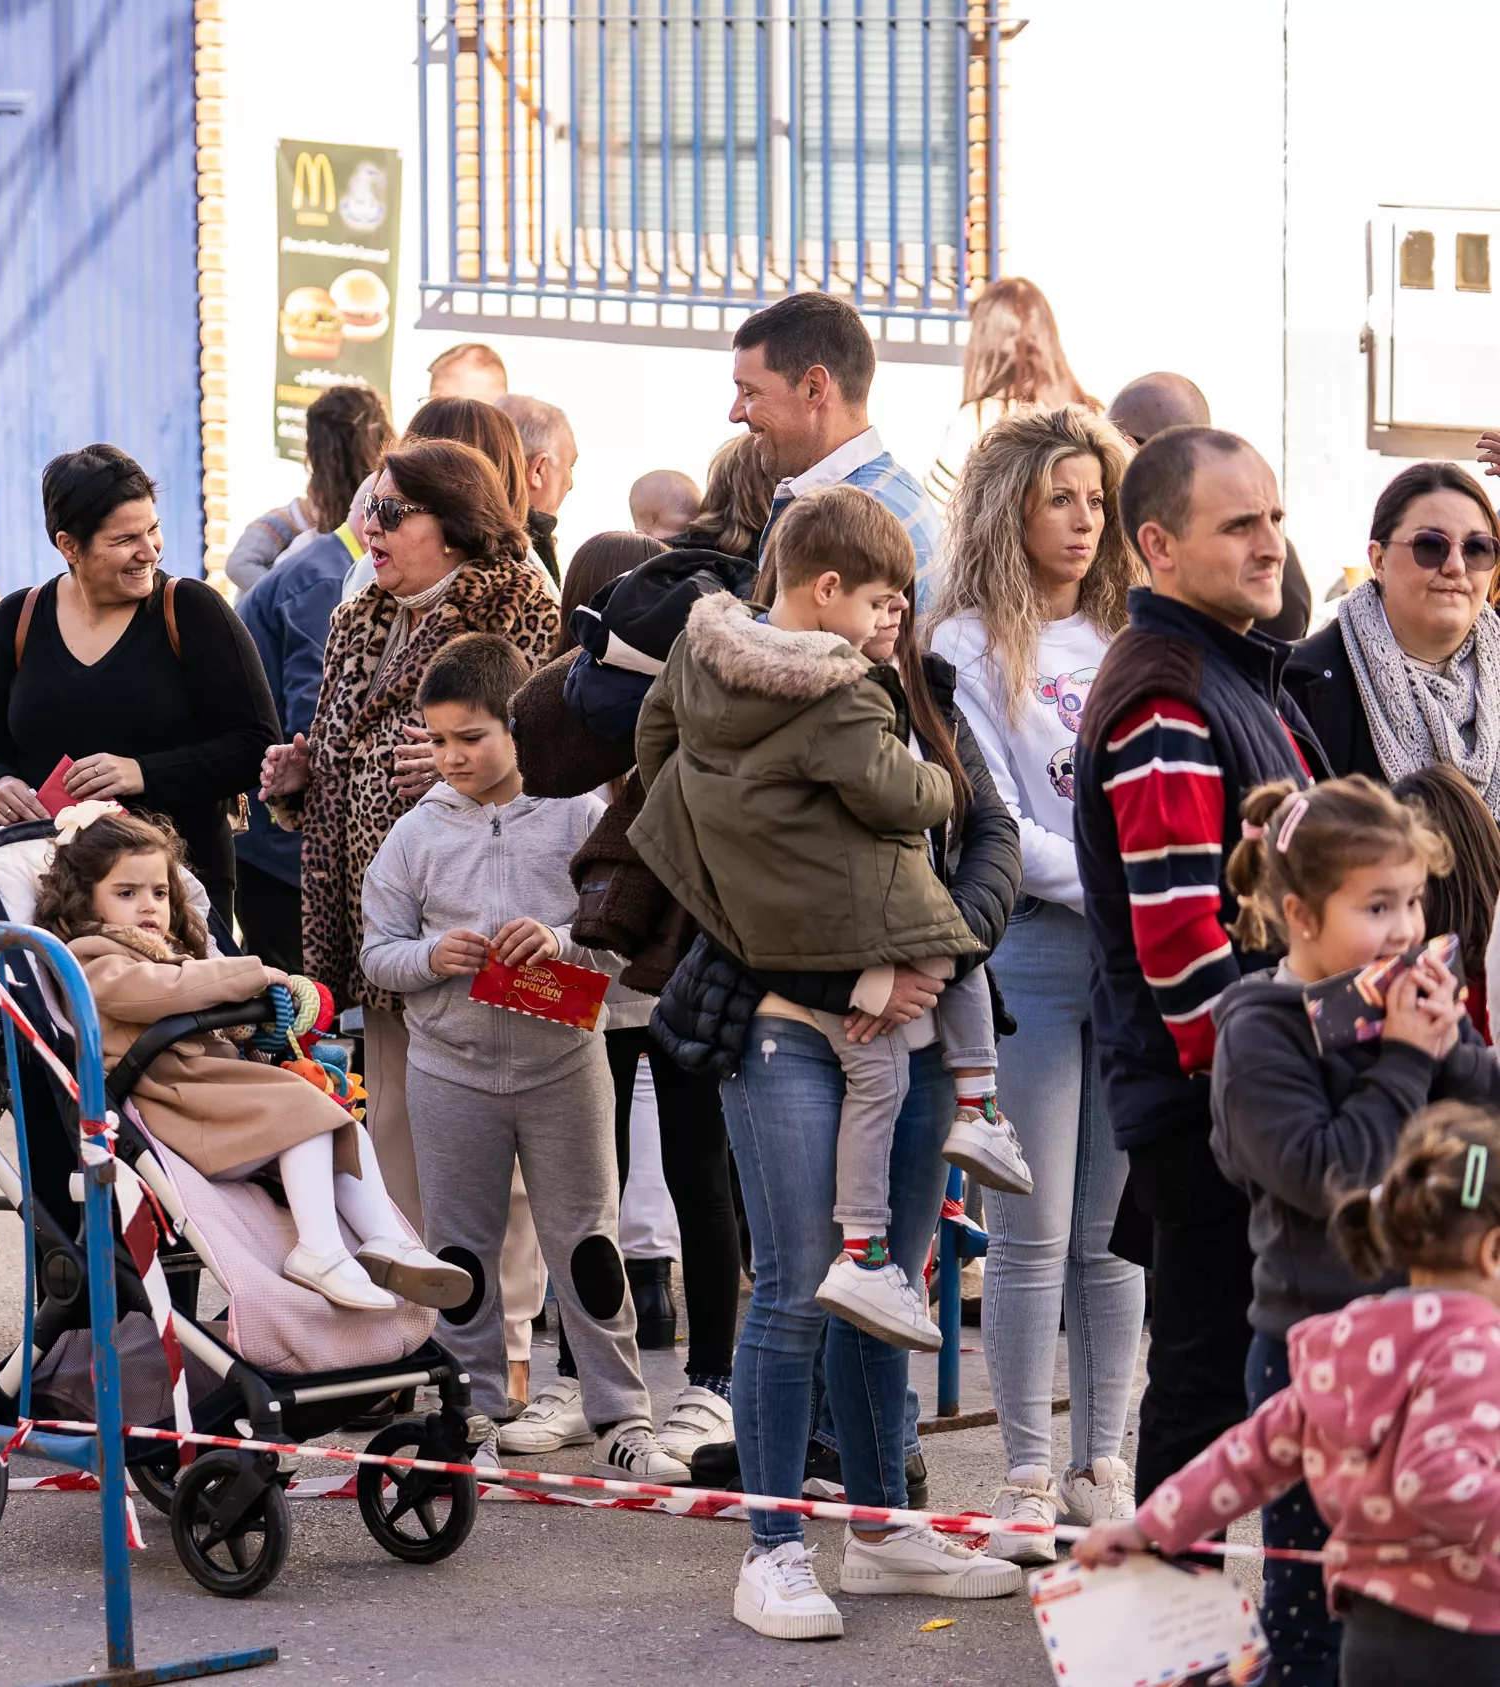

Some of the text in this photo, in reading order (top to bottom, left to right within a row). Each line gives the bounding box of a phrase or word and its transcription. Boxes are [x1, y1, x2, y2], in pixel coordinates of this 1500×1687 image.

[517, 965, 552, 980] PRECIO
[513, 978, 563, 999] NAVIDAD
[523, 974, 557, 988] al mejor
